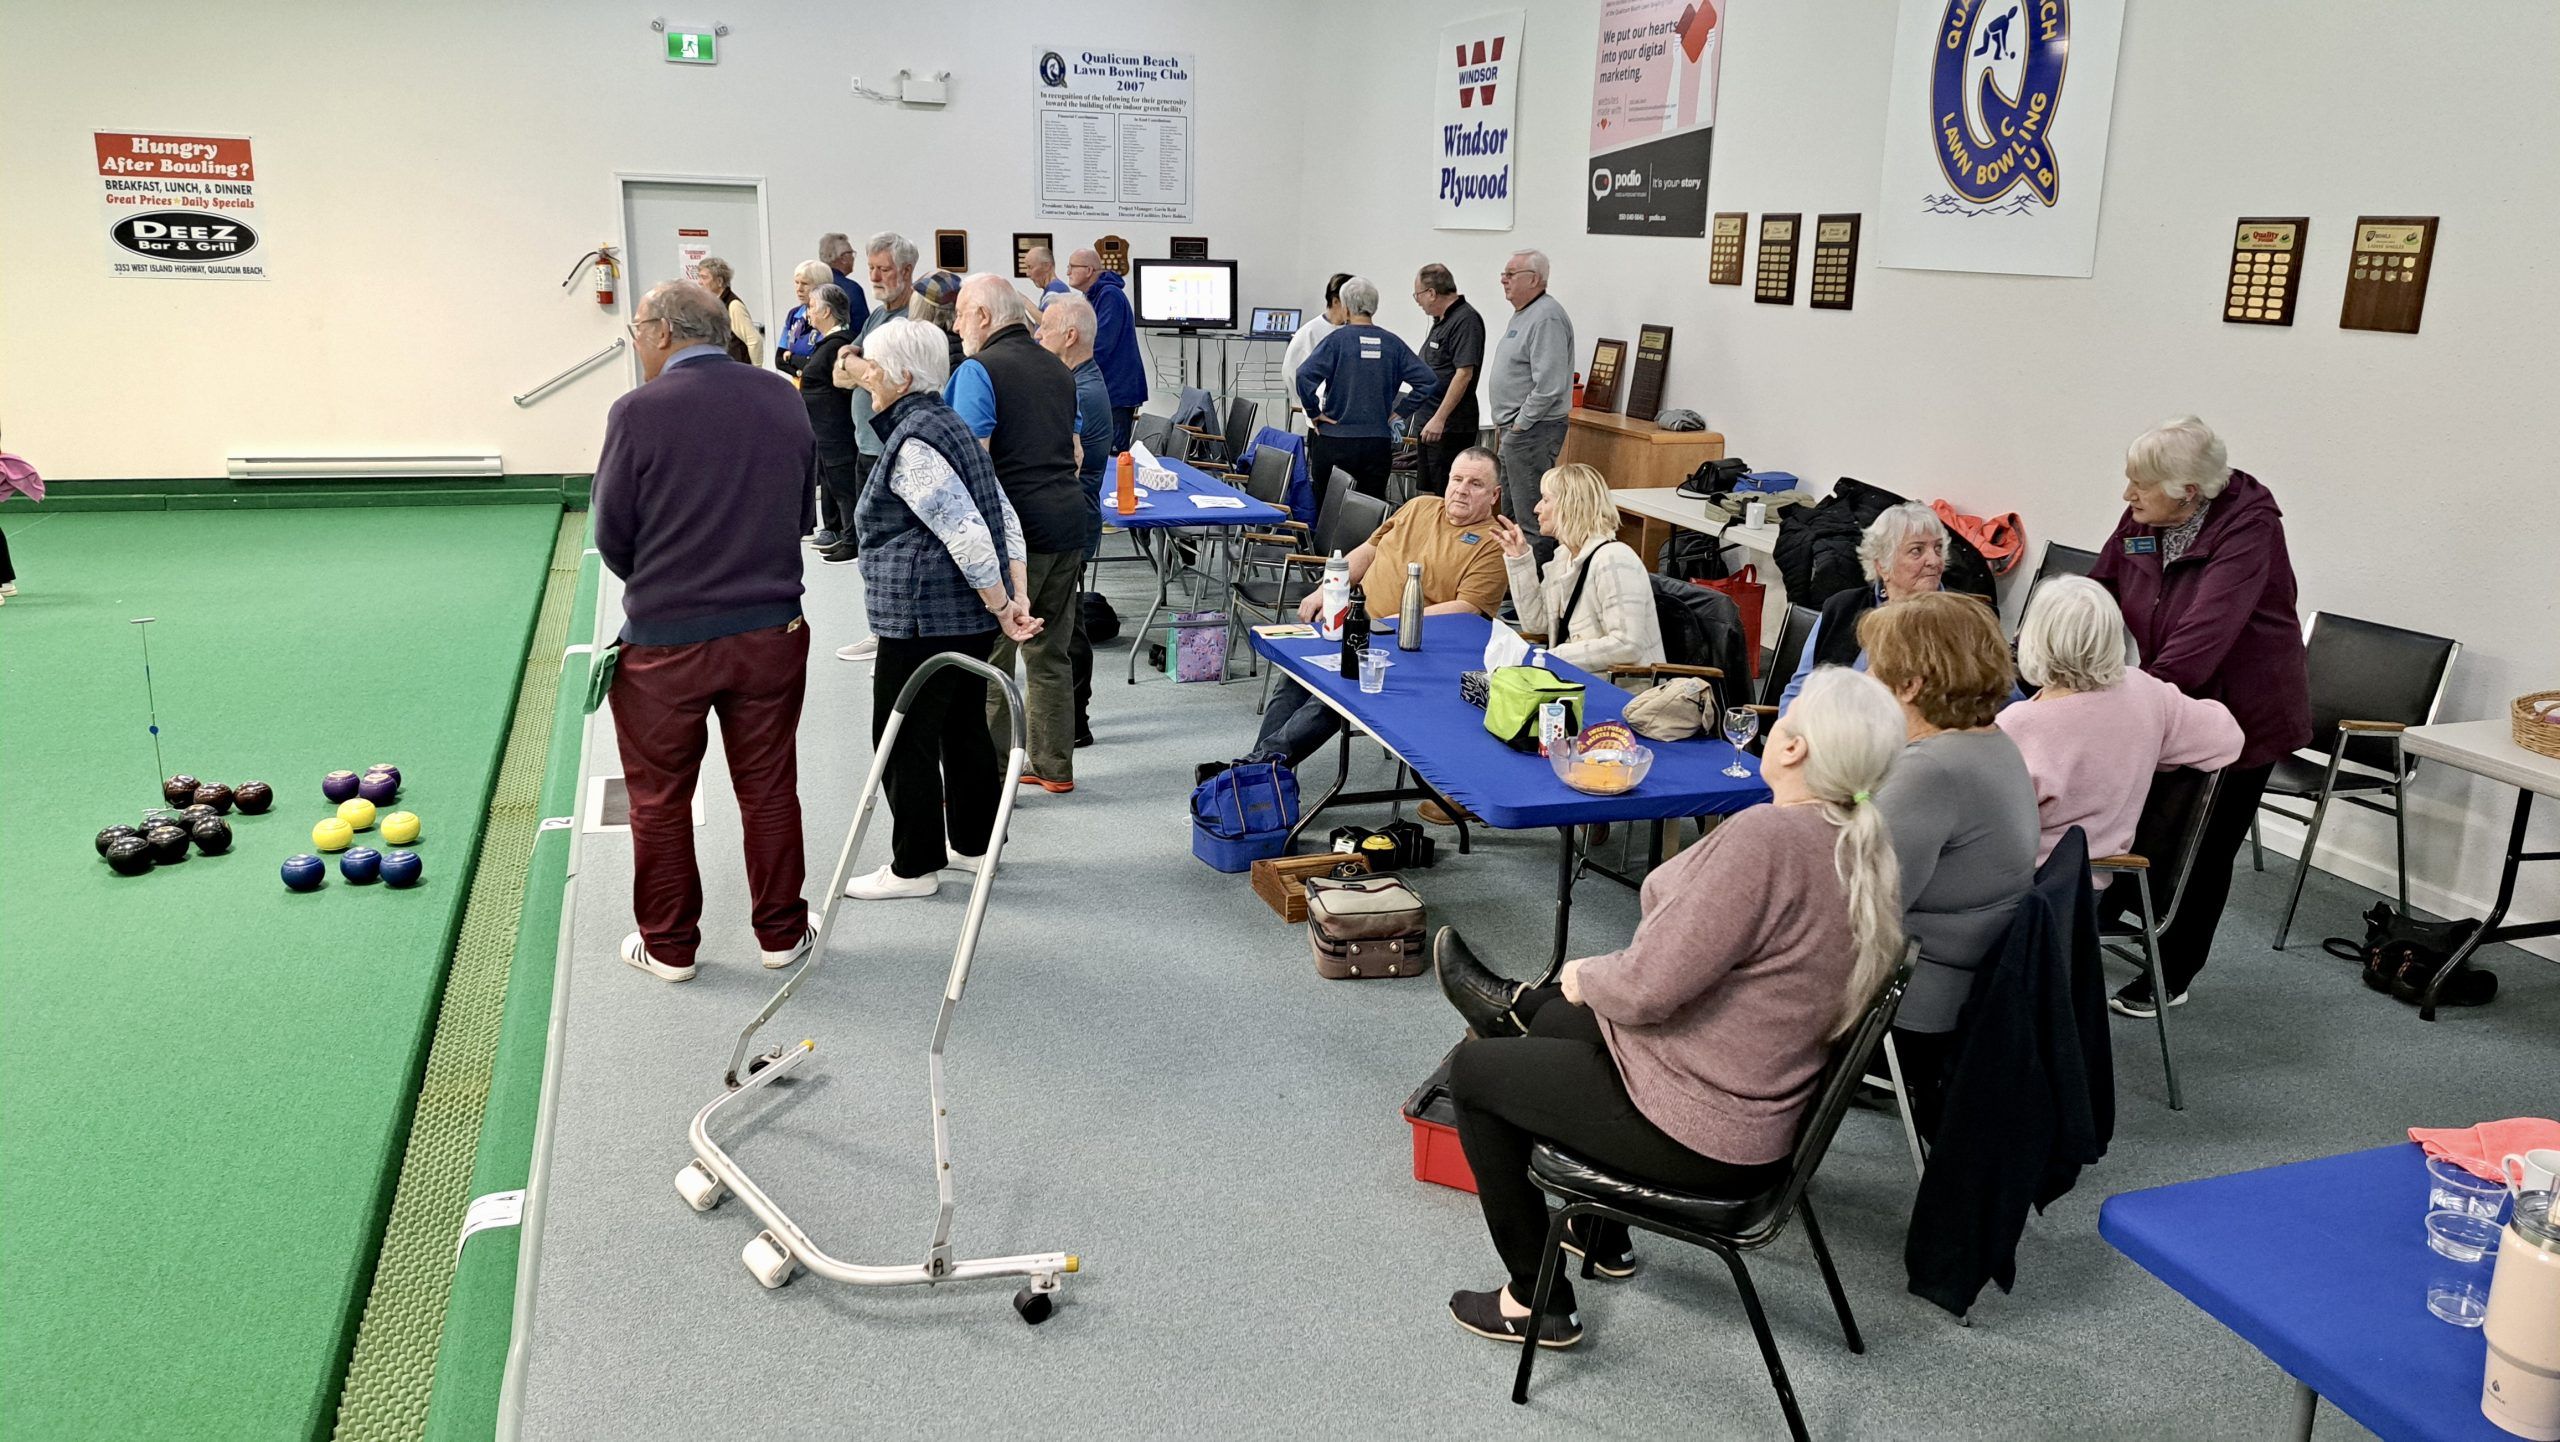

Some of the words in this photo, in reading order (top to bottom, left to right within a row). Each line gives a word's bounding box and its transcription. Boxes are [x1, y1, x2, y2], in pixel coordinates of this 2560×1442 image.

[2040, 0, 2058, 40] CH
[1603, 30, 1615, 44] We
[1616, 28, 1630, 46] put
[1632, 25, 1647, 39] our
[1648, 20, 1678, 36] hearts
[1081, 51, 1140, 65] Qualicum
[1143, 55, 1179, 68] Beach
[1601, 48, 1616, 64] into
[1617, 46, 1637, 65] your
[1638, 40, 1667, 61] digital
[1073, 63, 1106, 76] Lawn
[1109, 66, 1158, 81] Bowling
[1160, 68, 1188, 81] Club
[1458, 65, 1498, 86] WINDSOR
[1600, 66, 1642, 83] marketing.
[1116, 80, 1145, 92] 2007
[1048, 92, 1083, 100] recognition
[1102, 94, 1130, 103] following
[1131, 95, 1141, 103] for
[1141, 96, 1156, 104] their
[1156, 98, 1187, 106] generosity
[1079, 101, 1104, 110] building
[1122, 103, 1143, 111] indoor
[1161, 105, 1182, 113] facility
[1443, 120, 1508, 158] Windsor
[1942, 112, 1973, 176] LAWN
[1976, 92, 2048, 185] BOWLING
[131, 137, 218, 160] Hungry
[2000, 116, 2055, 189] CLUB
[102, 156, 155, 173] After
[160, 158, 250, 178] Bowling?
[105, 180, 162, 193] BREAKFAST,
[165, 182, 201, 195] LUNCH,
[204, 183, 212, 194] &
[214, 184, 252, 195] DINNER
[1439, 163, 1509, 208] Plywood
[1614, 168, 1642, 190] podio
[1663, 179, 1681, 191] your
[1681, 177, 1702, 191] story
[106, 193, 136, 204] Great
[140, 195, 172, 205] Prices
[181, 196, 209, 209] Daily
[212, 197, 255, 209] Specials
[138, 240, 171, 250] Bar
[176, 241, 190, 251] &
[196, 242, 236, 252] Grill
[131, 263, 148, 272] WEST
[149, 264, 173, 273] ISLAND
[174, 265, 206, 274] HIGHWAY,
[207, 265, 242, 275] QUALICUM
[242, 266, 263, 275] BEACH
